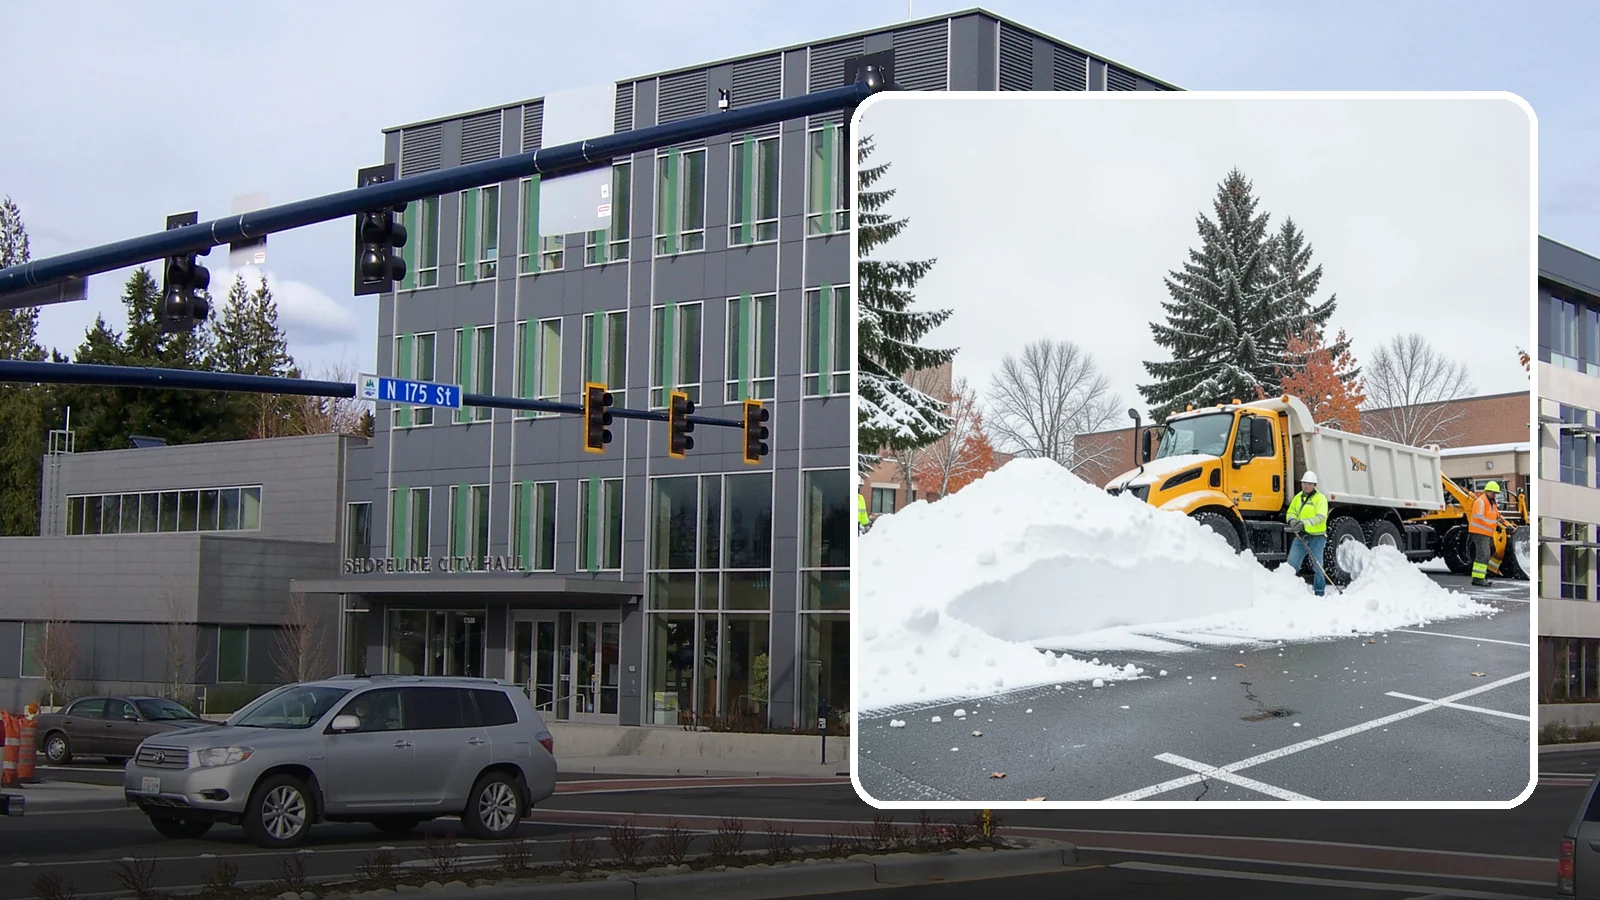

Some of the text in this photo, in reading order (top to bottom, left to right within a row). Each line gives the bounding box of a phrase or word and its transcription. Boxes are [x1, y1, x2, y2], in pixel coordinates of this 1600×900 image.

[387, 380, 451, 406] N 175 St
[344, 555, 525, 574] SHORELINE CITY HALL
